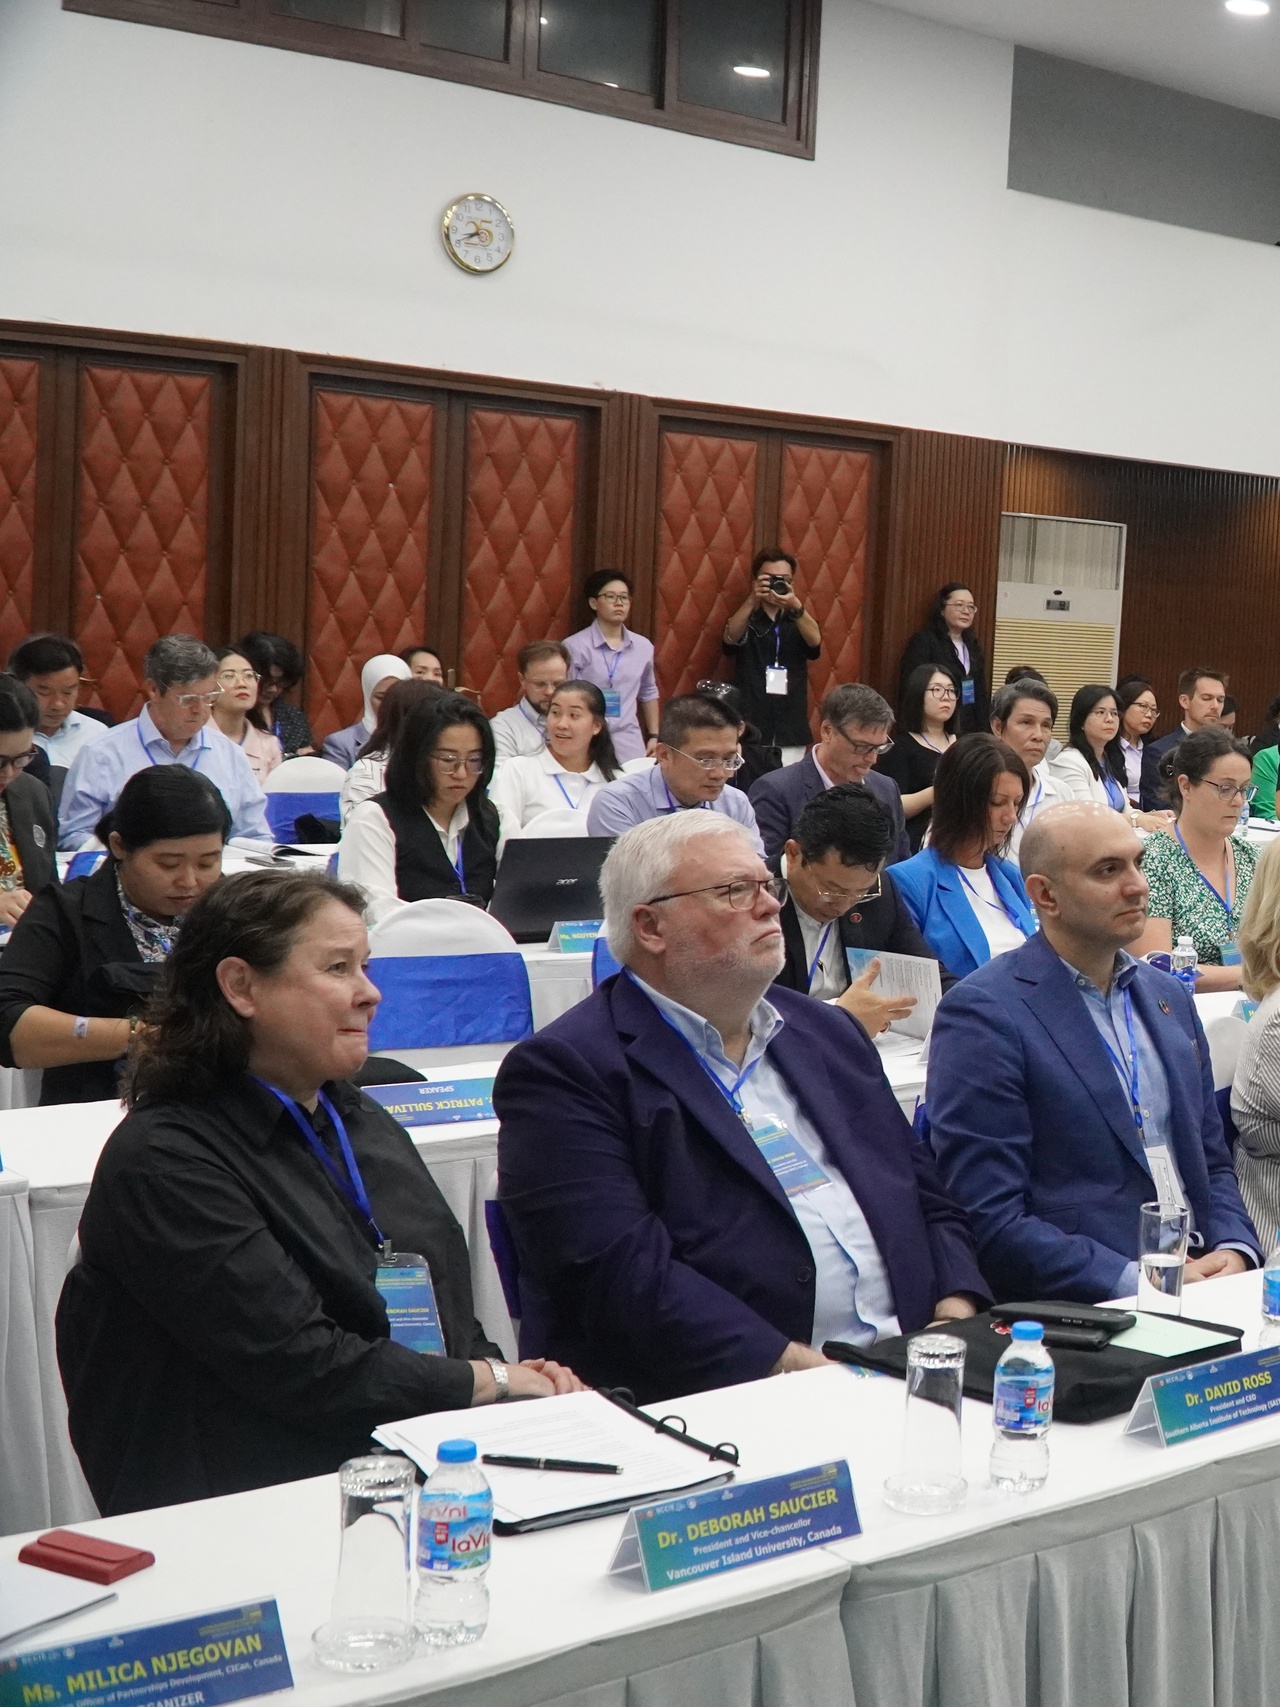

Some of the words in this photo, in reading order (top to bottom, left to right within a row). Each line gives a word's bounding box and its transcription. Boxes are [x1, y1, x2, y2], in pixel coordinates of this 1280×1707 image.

[474, 202, 483, 211] 12
[451, 226, 458, 234] 9
[419, 1085, 454, 1094] SPEAKER
[437, 1098, 483, 1109] PATRICK
[384, 1102, 433, 1114] SULLIVA
[1185, 1393, 1203, 1407] Dr.
[1204, 1380, 1241, 1401] DAVID
[1243, 1371, 1272, 1391] ROSS
[1210, 1400, 1234, 1413] President
[1235, 1398, 1245, 1406] and
[1246, 1393, 1256, 1403] CEO
[1164, 1425, 1189, 1439] Southern
[1190, 1419, 1209, 1432] Alberta
[1210, 1412, 1232, 1426] Institute
[1239, 1404, 1268, 1418] Technology
[657, 1531, 683, 1549] Dr.
[687, 1507, 766, 1541] DEBORAH
[769, 1489, 838, 1520] SAUCIER
[666, 1560, 720, 1581] Vancouver
[721, 1549, 753, 1566] Island
[754, 1536, 806, 1557] University,
[807, 1525, 842, 1543] Canada
[693, 1539, 734, 1556] President
[734, 1533, 750, 1545] and
[750, 1518, 812, 1541] Vice-chancellor
[22, 1683, 61, 1707] Ms.
[66, 1661, 148, 1695] MILICA
[151, 1634, 262, 1675] NJEGOVAN
[106, 1690, 116, 1702] of
[117, 1680, 169, 1701] Partnerships
[169, 1669, 225, 1688] Development,
[253, 1654, 283, 1668] Canada
